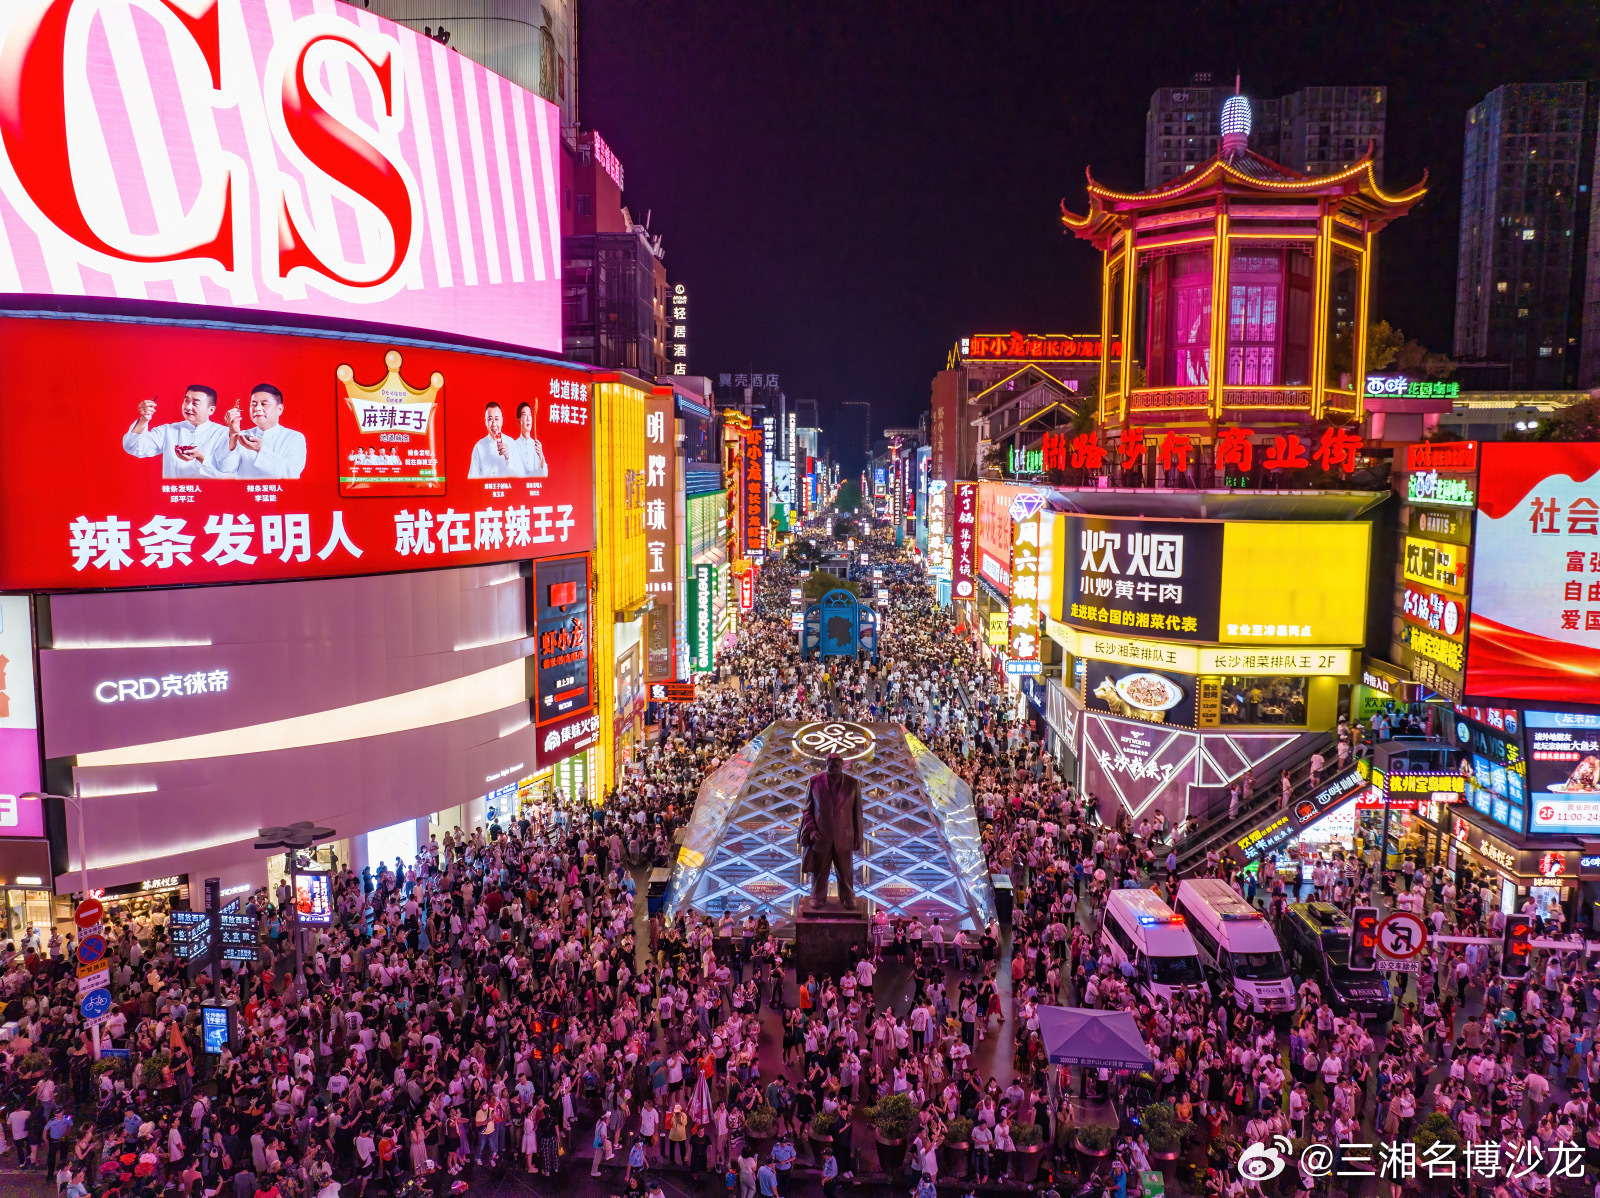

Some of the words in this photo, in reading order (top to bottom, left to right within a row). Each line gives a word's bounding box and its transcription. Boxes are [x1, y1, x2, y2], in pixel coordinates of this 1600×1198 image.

[0, 0, 413, 288] CS
[673, 307, 687, 375] 轻居酒店
[549, 378, 588, 402] 地道辣条
[719, 373, 779, 387] 翼壳酒店
[362, 405, 427, 430] 麻辣王子
[549, 405, 588, 426] 麻辣王子
[747, 429, 763, 481] 虾小龙
[162, 485, 202, 493] 辣条发明人
[170, 495, 195, 503] 邱平江
[247, 484, 284, 492] 辣条发明人
[646, 411, 668, 573] 明牌珠宝
[1529, 496, 1600, 536] 社会
[69, 510, 364, 572] 辣条发明人
[394, 505, 575, 557] 就在麻辣王子
[1080, 529, 1184, 579] 炊烟
[1013, 520, 1039, 659] 周六福珠宝
[1080, 576, 1183, 605] 小炒黄牛肉
[697, 566, 709, 668] metersbonwe
[1070, 602, 1198, 633] 走进联合国的湘菜代表
[542, 617, 585, 656] 虾小龙
[1226, 623, 1312, 638] 营业至凌晨两点
[1094, 641, 1177, 664] 长沙湘菜排队王
[1214, 655, 1312, 669] 长沙湘菜排队王
[1318, 655, 1336, 668] 2F
[1098, 750, 1174, 783] 长沙我来了
[1390, 775, 1465, 793] 杭州宝岛眼镜
[1540, 808, 1554, 818] 2F
[221, 915, 250, 925] 解放西路
[223, 932, 250, 941] 火宫殿
[1379, 961, 1418, 971] 公交车除外
